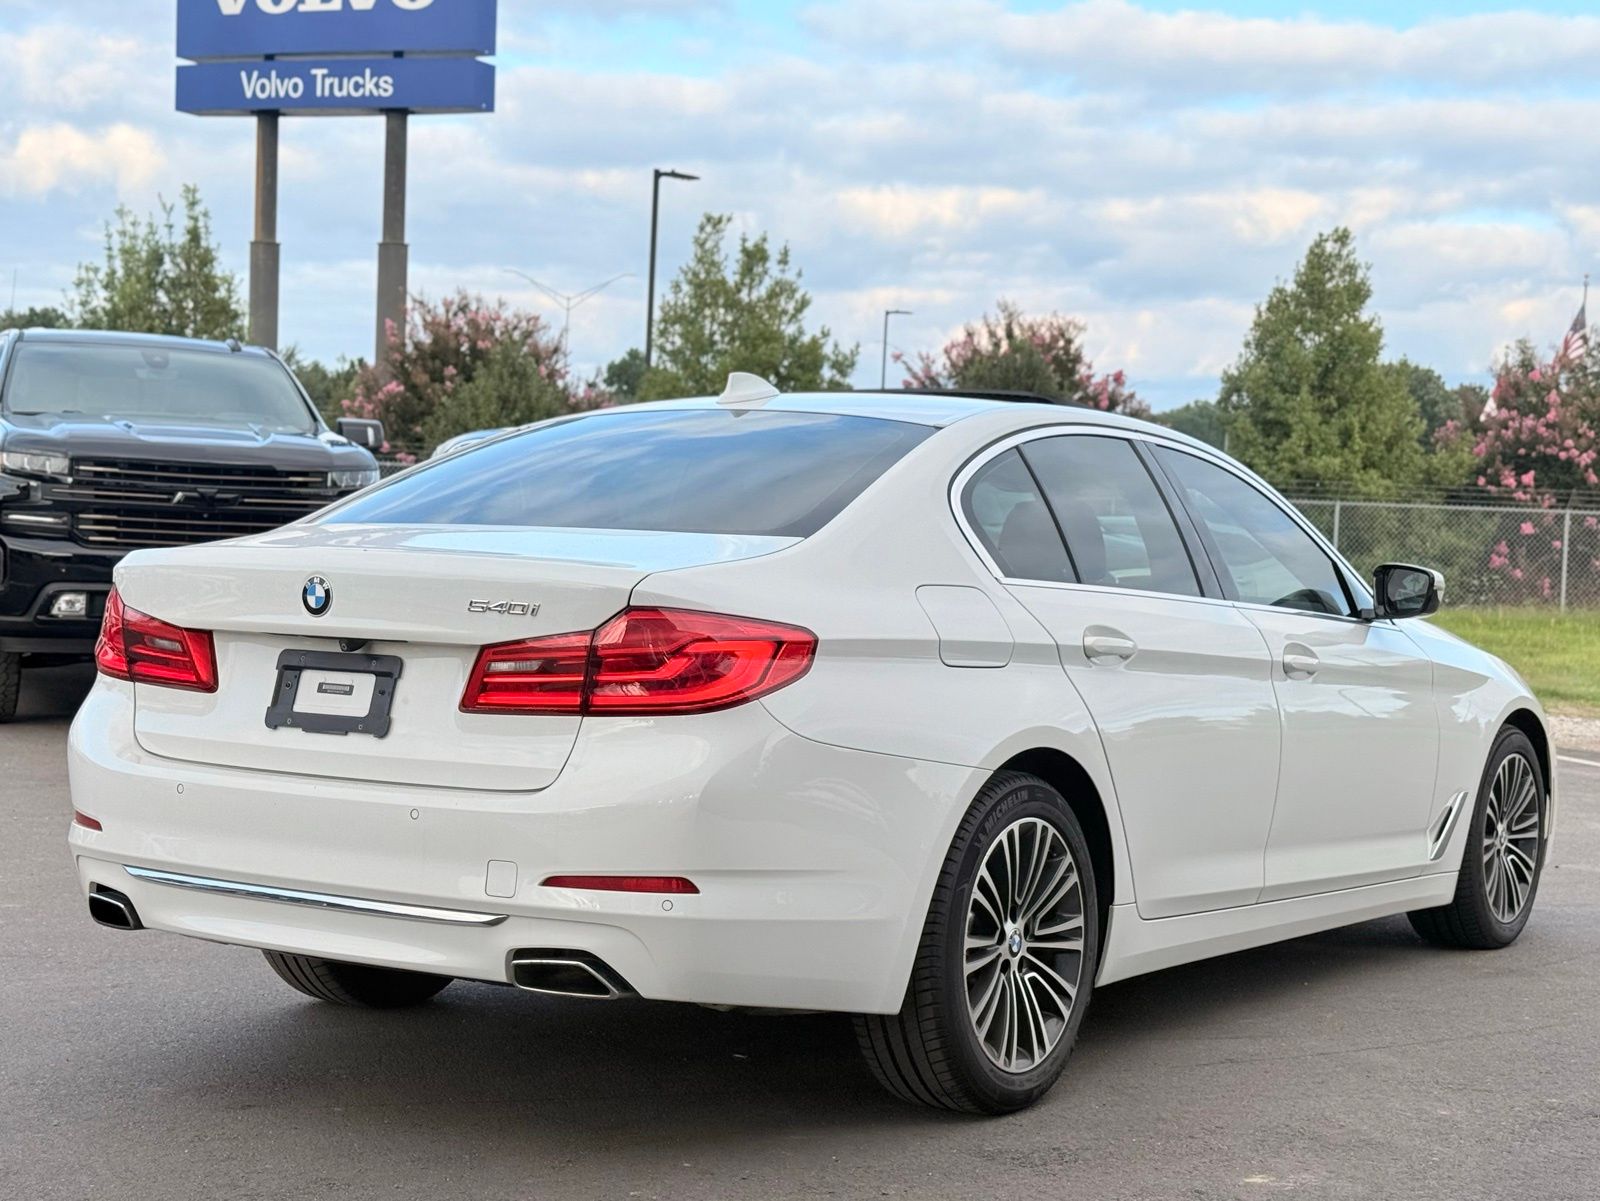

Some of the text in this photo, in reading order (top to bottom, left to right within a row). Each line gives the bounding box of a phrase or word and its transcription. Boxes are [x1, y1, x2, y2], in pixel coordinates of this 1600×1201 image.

[240, 67, 394, 99] Volvo Trucks
[467, 599, 541, 617] 540i
[984, 789, 1029, 833] MICHELIN
